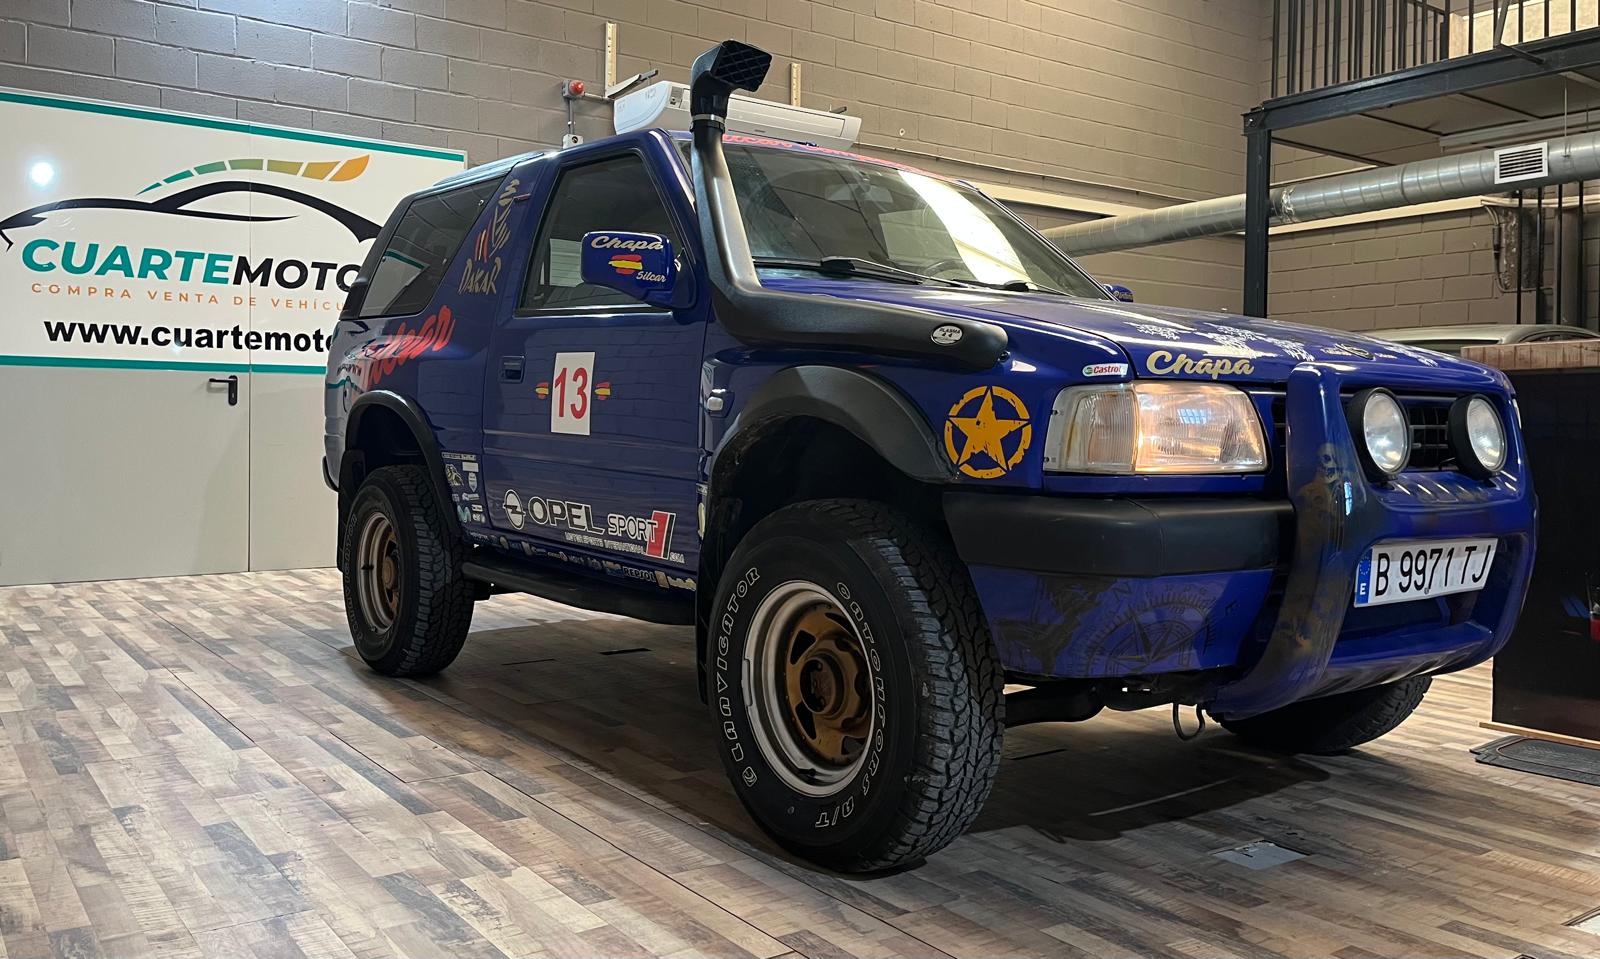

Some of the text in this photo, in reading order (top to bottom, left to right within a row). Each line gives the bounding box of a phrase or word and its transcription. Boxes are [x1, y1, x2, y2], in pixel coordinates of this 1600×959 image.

[591, 235, 664, 251] Chapa
[31, 283, 131, 299] COMPRA
[147, 290, 219, 305] VENTA
[233, 296, 256, 306] DE
[1093, 363, 1122, 374] Castrol
[1146, 351, 1254, 380] Chapa
[553, 367, 589, 420] 13
[528, 496, 659, 543] OPEL SPORT
[1375, 544, 1491, 596] B 9971 TJ
[1359, 582, 1367, 595] E
